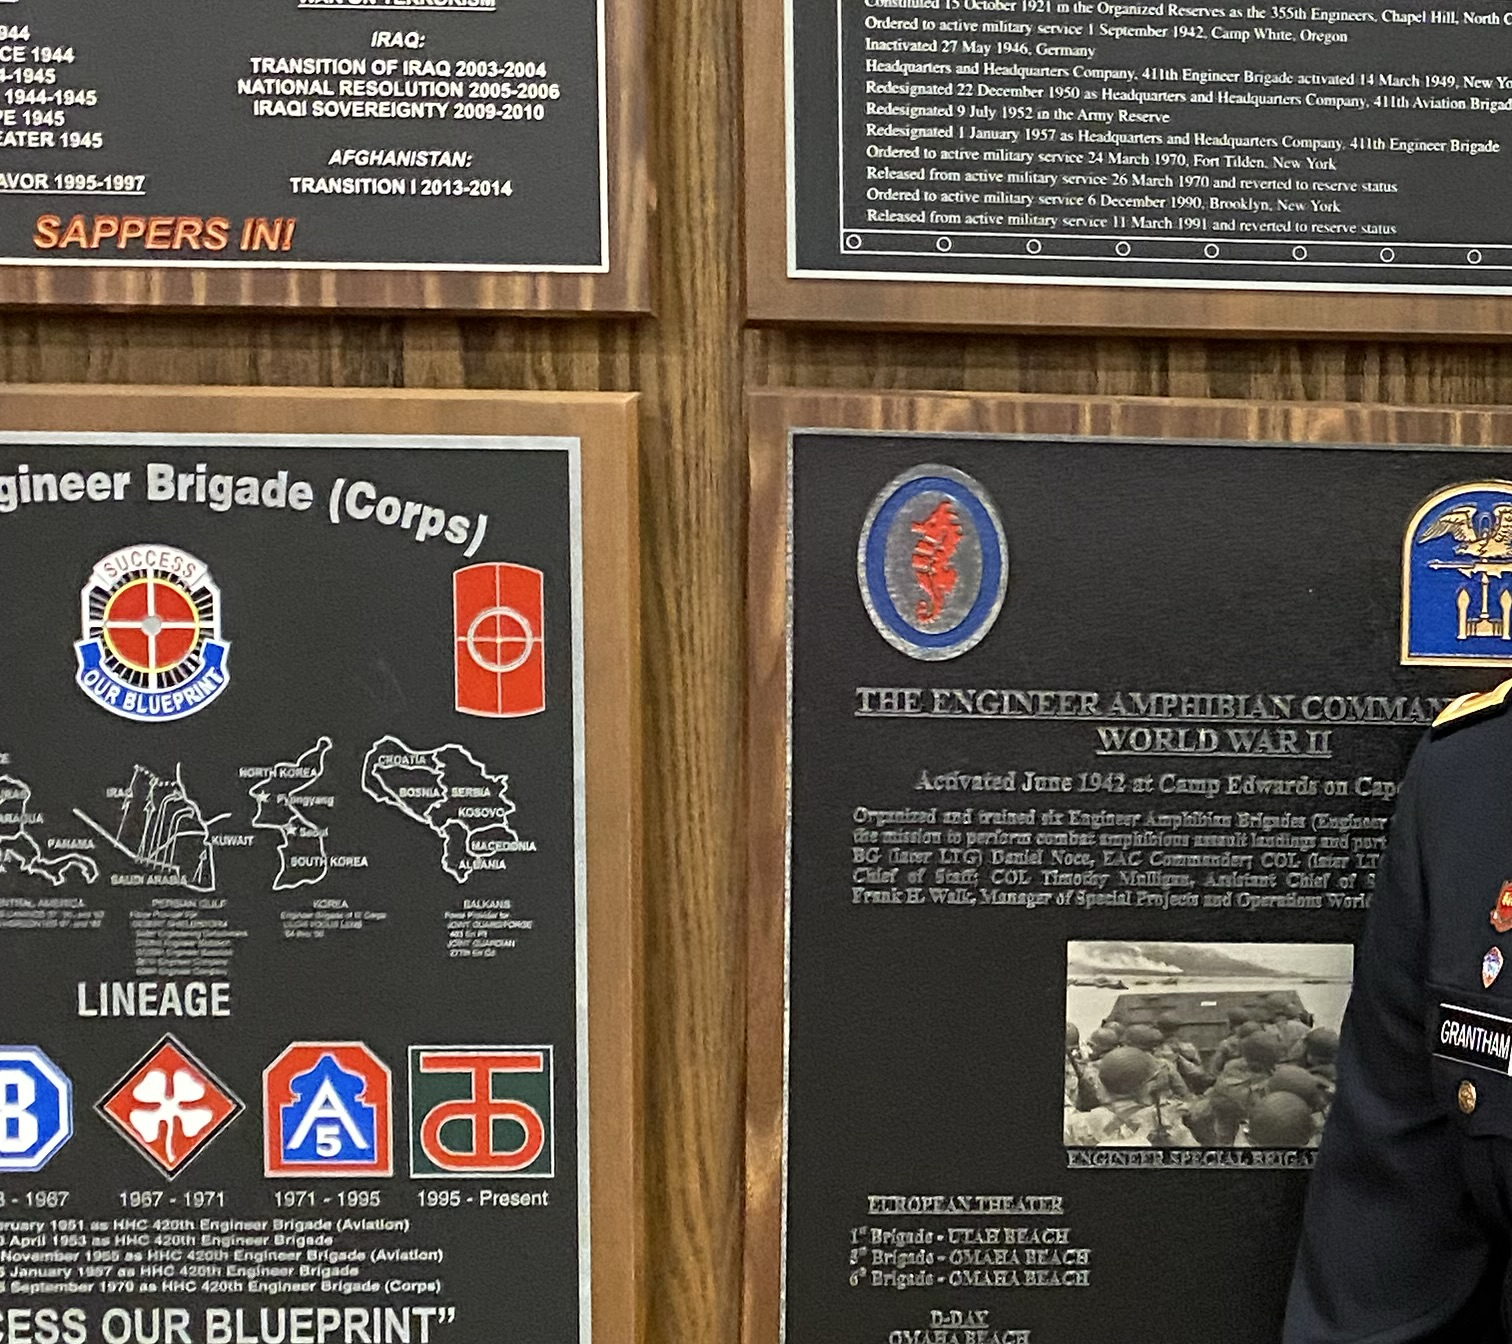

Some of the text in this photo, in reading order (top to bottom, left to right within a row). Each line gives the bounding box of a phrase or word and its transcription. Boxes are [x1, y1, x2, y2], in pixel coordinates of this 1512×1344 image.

[371, 31, 425, 49] IRAQ:
[866, 38, 937, 52] Inactivated
[942, 40, 957, 52] 27
[963, 41, 991, 56] May
[1036, 44, 1096, 60] Germany
[251, 57, 546, 78] TRANSITION OF IRAQ 2003-2004
[238, 78, 560, 99] NATIONAL RESOLUTION 2005-2006
[254, 100, 544, 120] IRAQI SOVEREIGNTY 2009-2010
[867, 102, 1169, 124] Redesignated 9 July 1952 in the Army Reserve
[328, 149, 472, 167] AFGHANISTAN:
[290, 177, 405, 194] TRANSITION
[421, 179, 512, 196] 2013-2014
[34, 215, 295, 251] SAPPERS IN!
[147, 462, 314, 512] Brigade
[329, 478, 489, 559] (Corps)
[104, 550, 197, 578] SUCCESS
[83, 666, 225, 715] OUR BLUEPRINT
[855, 687, 929, 715] THE
[931, 688, 1102, 717] ENGINEER
[1107, 692, 1295, 720] AMPHIBIAN
[1096, 726, 1332, 754] WORLD WAR II
[914, 770, 1016, 791] Activated
[1022, 771, 1072, 792] June
[1078, 772, 1126, 793] 1942
[1133, 774, 1154, 792] at
[1159, 773, 1220, 799] Camp
[1226, 774, 1319, 795] Edwards
[1325, 781, 1347, 795] on
[78, 982, 230, 1016] LINEAGE
[1441, 1019, 1512, 1060] GRANTHAM
[120, 1191, 163, 1207] 1967
[184, 1191, 223, 1207] 1971
[275, 1191, 314, 1207] 1971
[338, 1191, 380, 1206] 1995
[418, 1190, 460, 1206] 1995
[480, 1190, 548, 1206] Present
[102, 1308, 191, 1344] OUR
